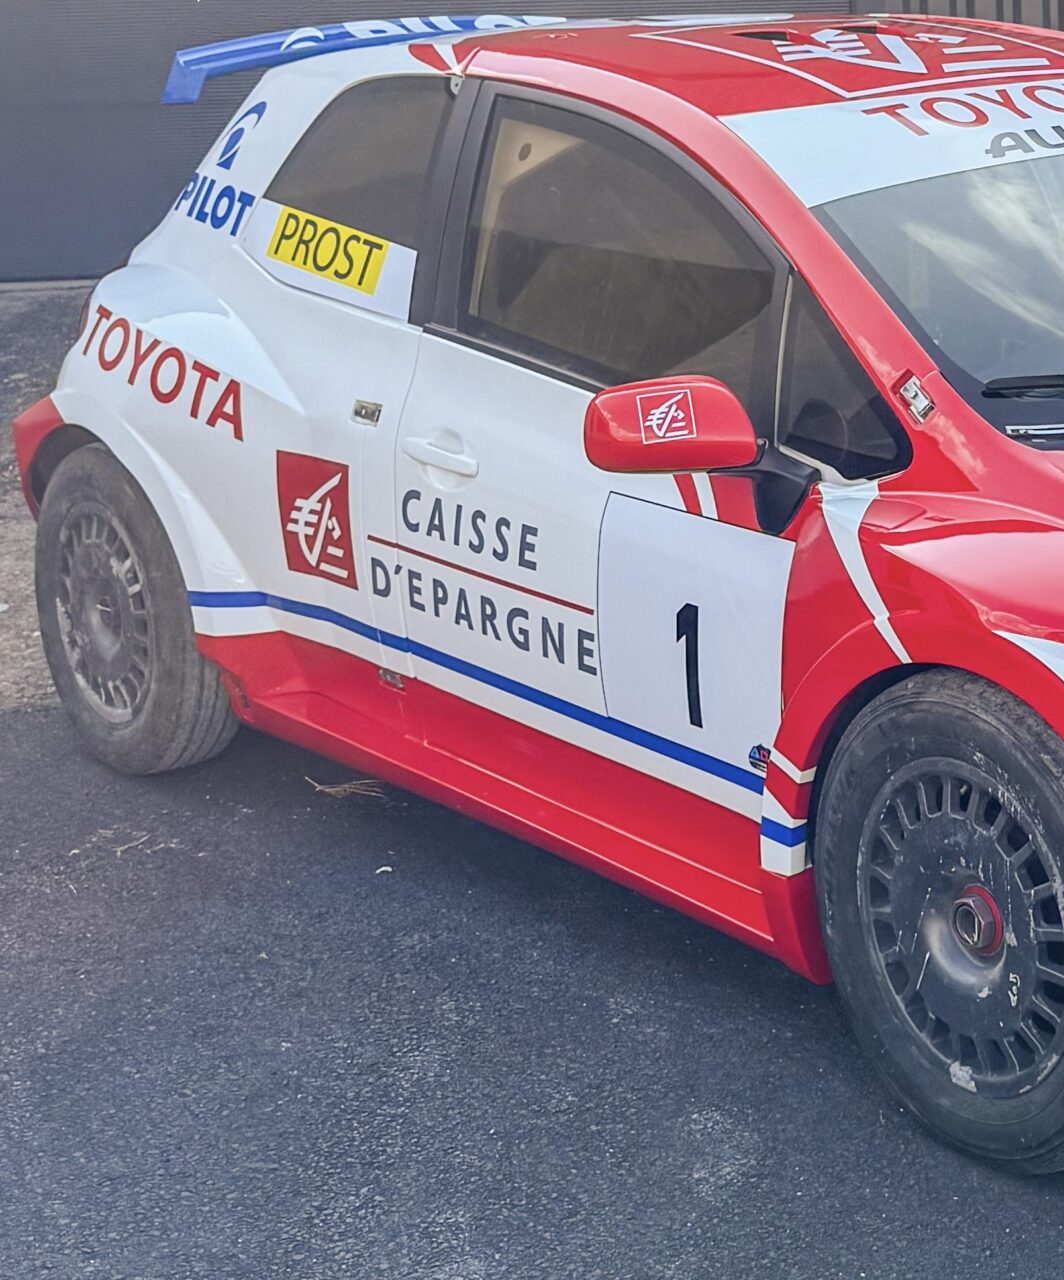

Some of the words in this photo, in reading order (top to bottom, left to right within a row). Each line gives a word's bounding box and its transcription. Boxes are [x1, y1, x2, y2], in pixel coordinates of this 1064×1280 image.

[174, 172, 256, 237] PILOT
[273, 212, 384, 287] PROST
[82, 304, 244, 443] TOYOTA
[401, 489, 539, 572] CAISSE
[370, 556, 598, 676] D'EPARGNE
[676, 602, 703, 728] 1
